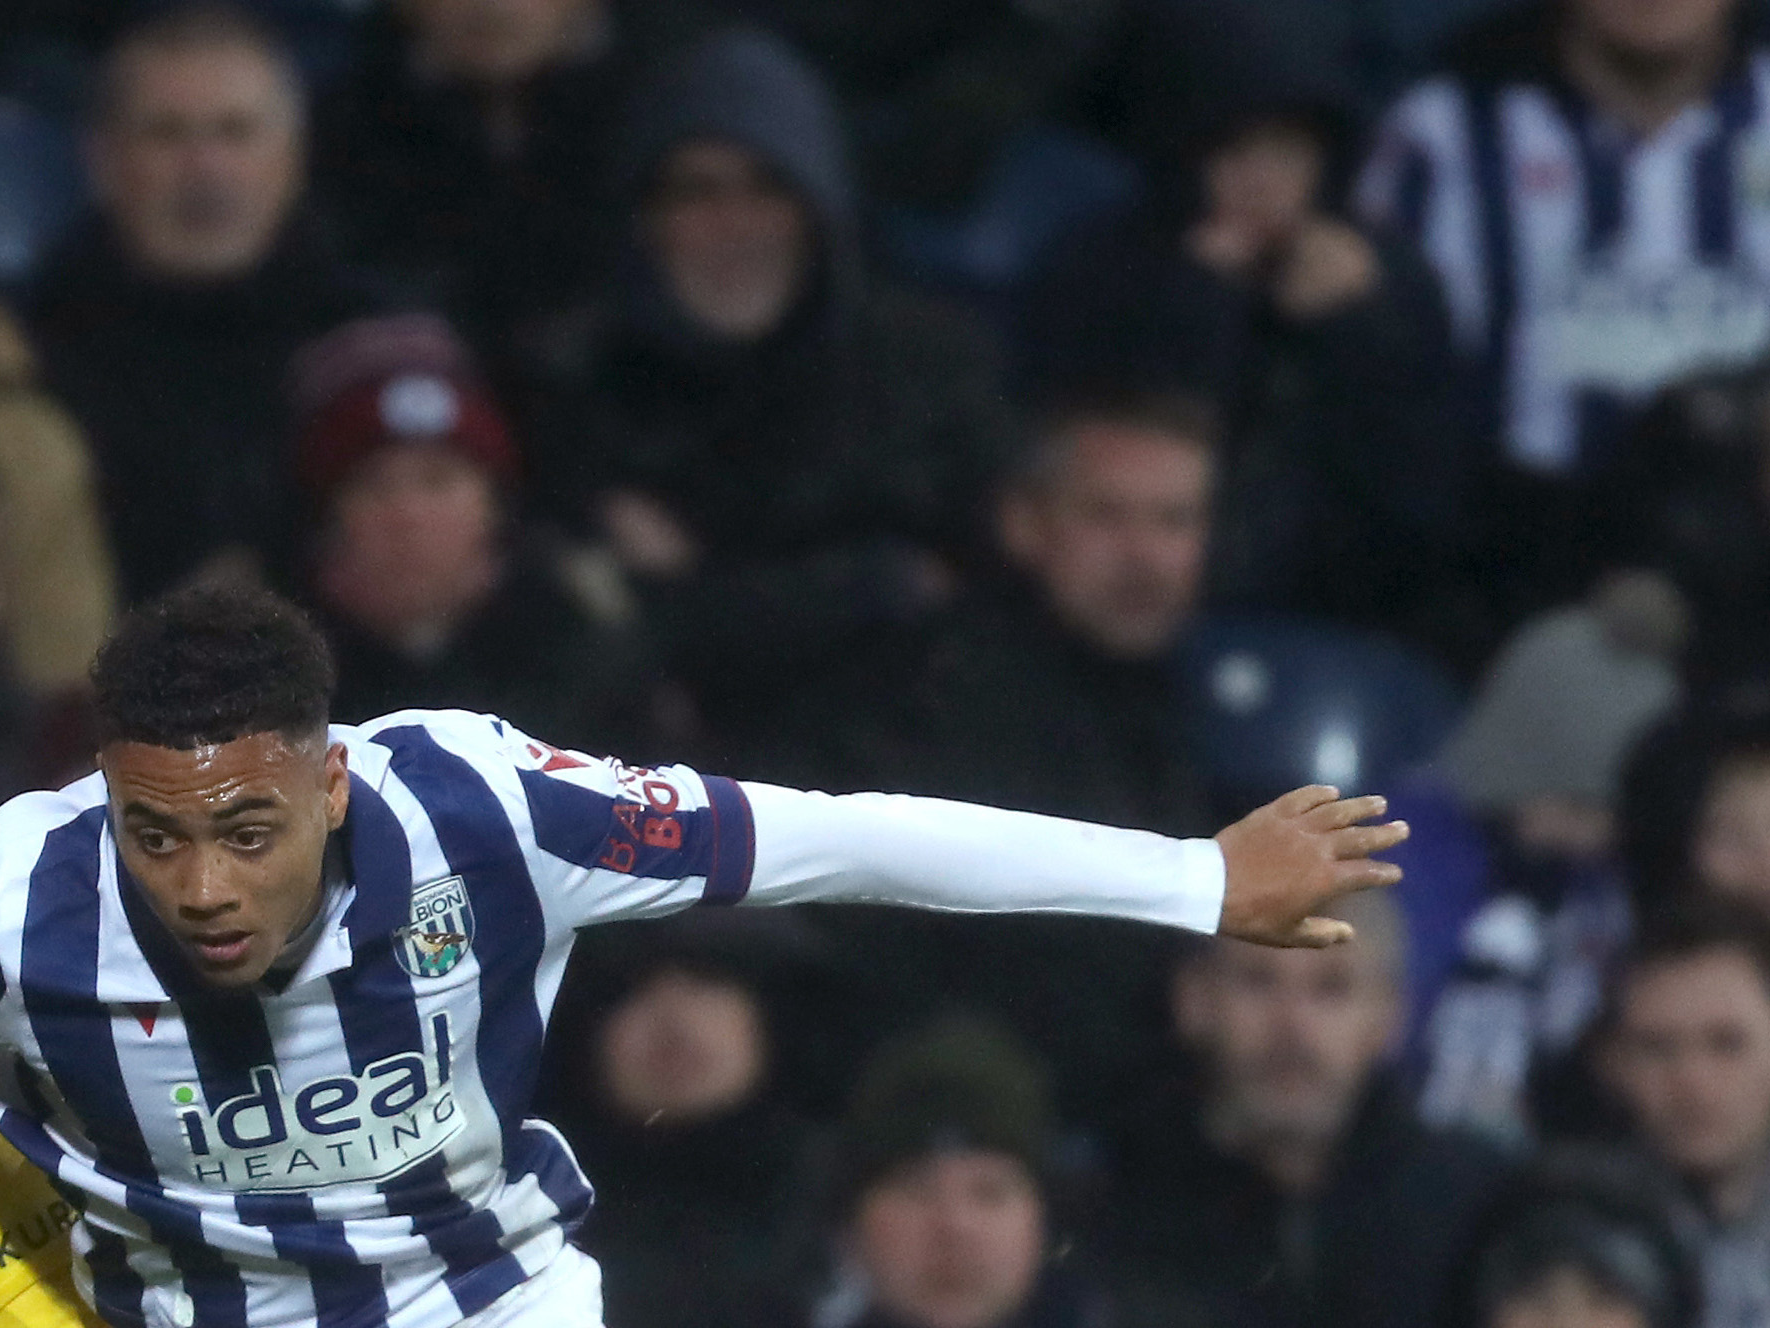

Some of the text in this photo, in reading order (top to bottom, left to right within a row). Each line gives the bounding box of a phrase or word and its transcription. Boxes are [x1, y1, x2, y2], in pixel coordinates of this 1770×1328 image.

[415, 890, 464, 922] BION
[173, 1012, 453, 1157] ideal
[194, 1091, 457, 1184] HEATING
